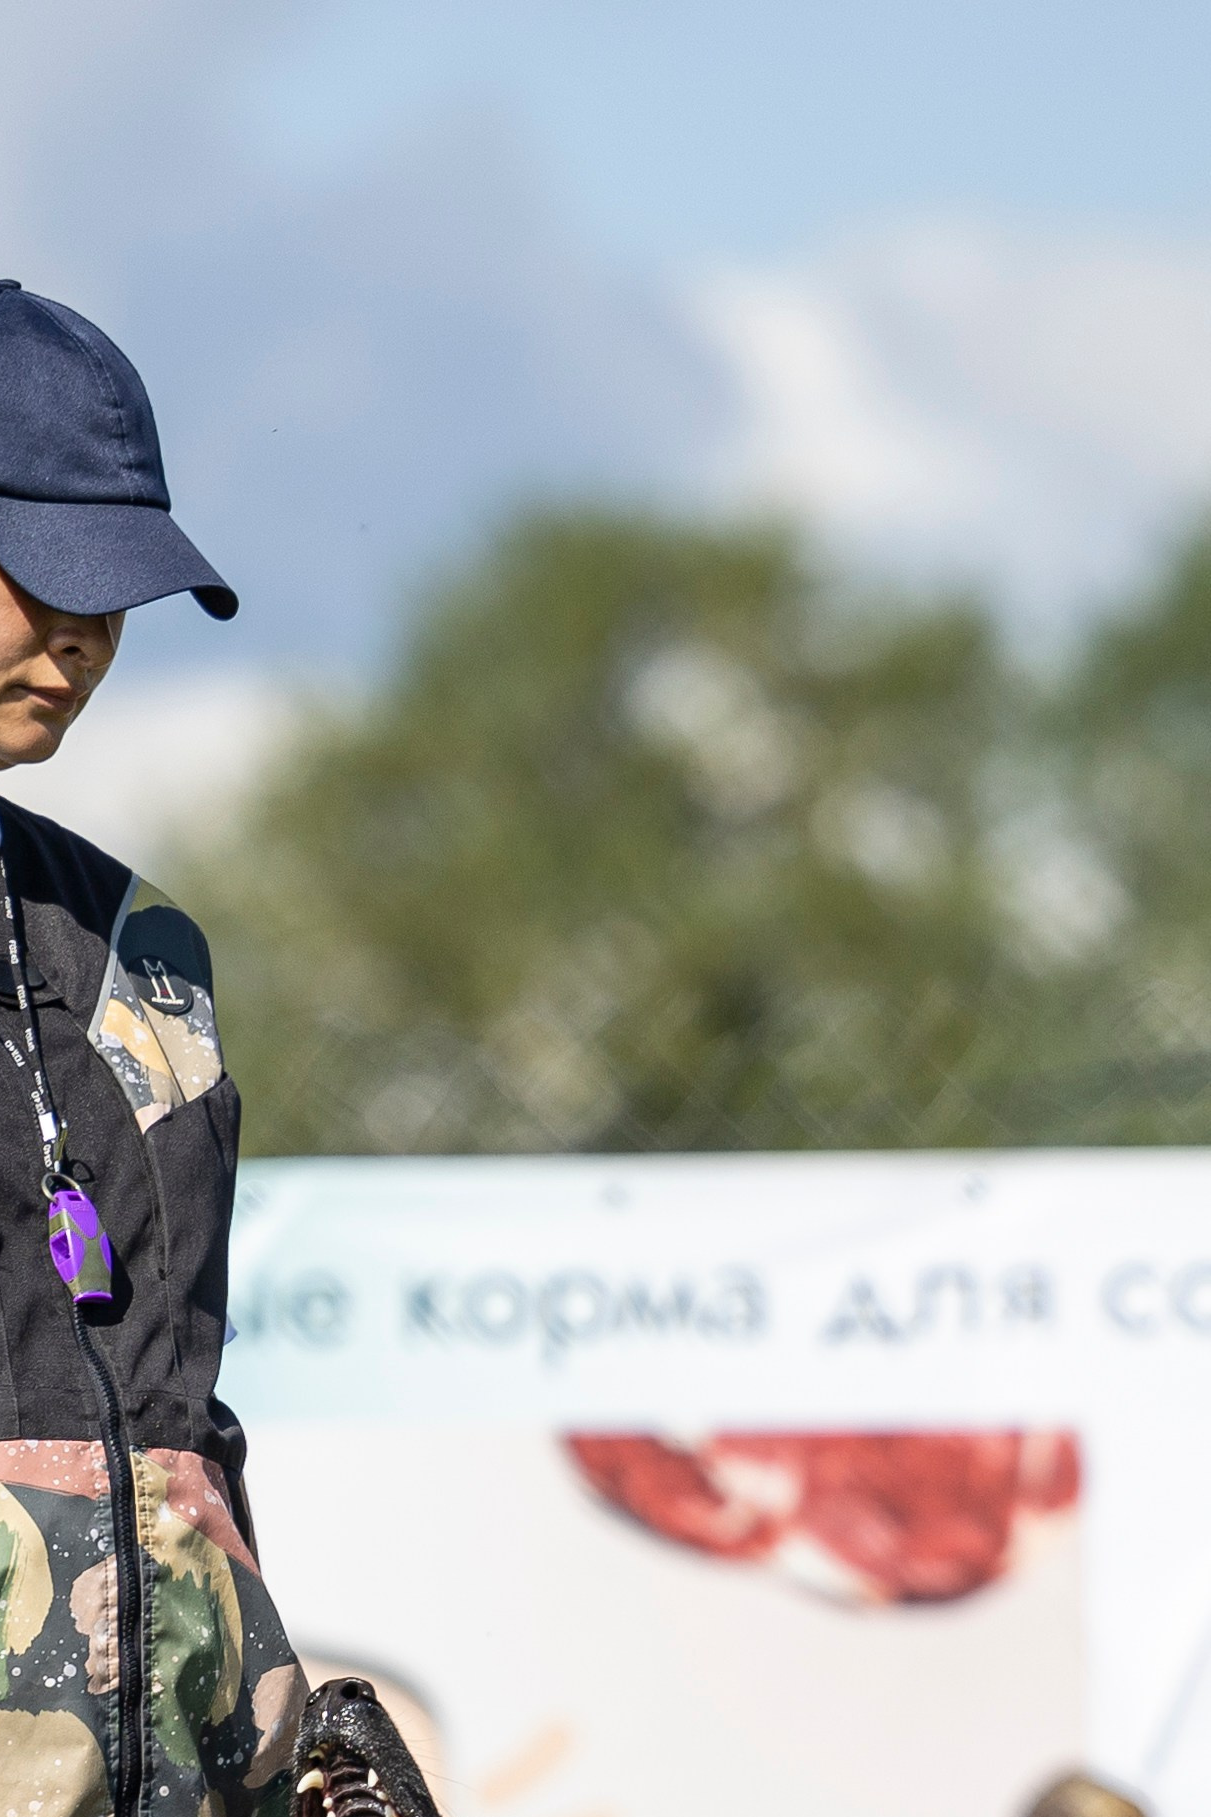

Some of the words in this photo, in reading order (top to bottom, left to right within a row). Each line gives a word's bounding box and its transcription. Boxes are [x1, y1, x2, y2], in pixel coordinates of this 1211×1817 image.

[4, 1039, 26, 1068] FOX40
[30, 1090, 46, 1115] OX40
[400, 1266, 770, 1370] корма
[819, 1264, 1055, 1345] для
